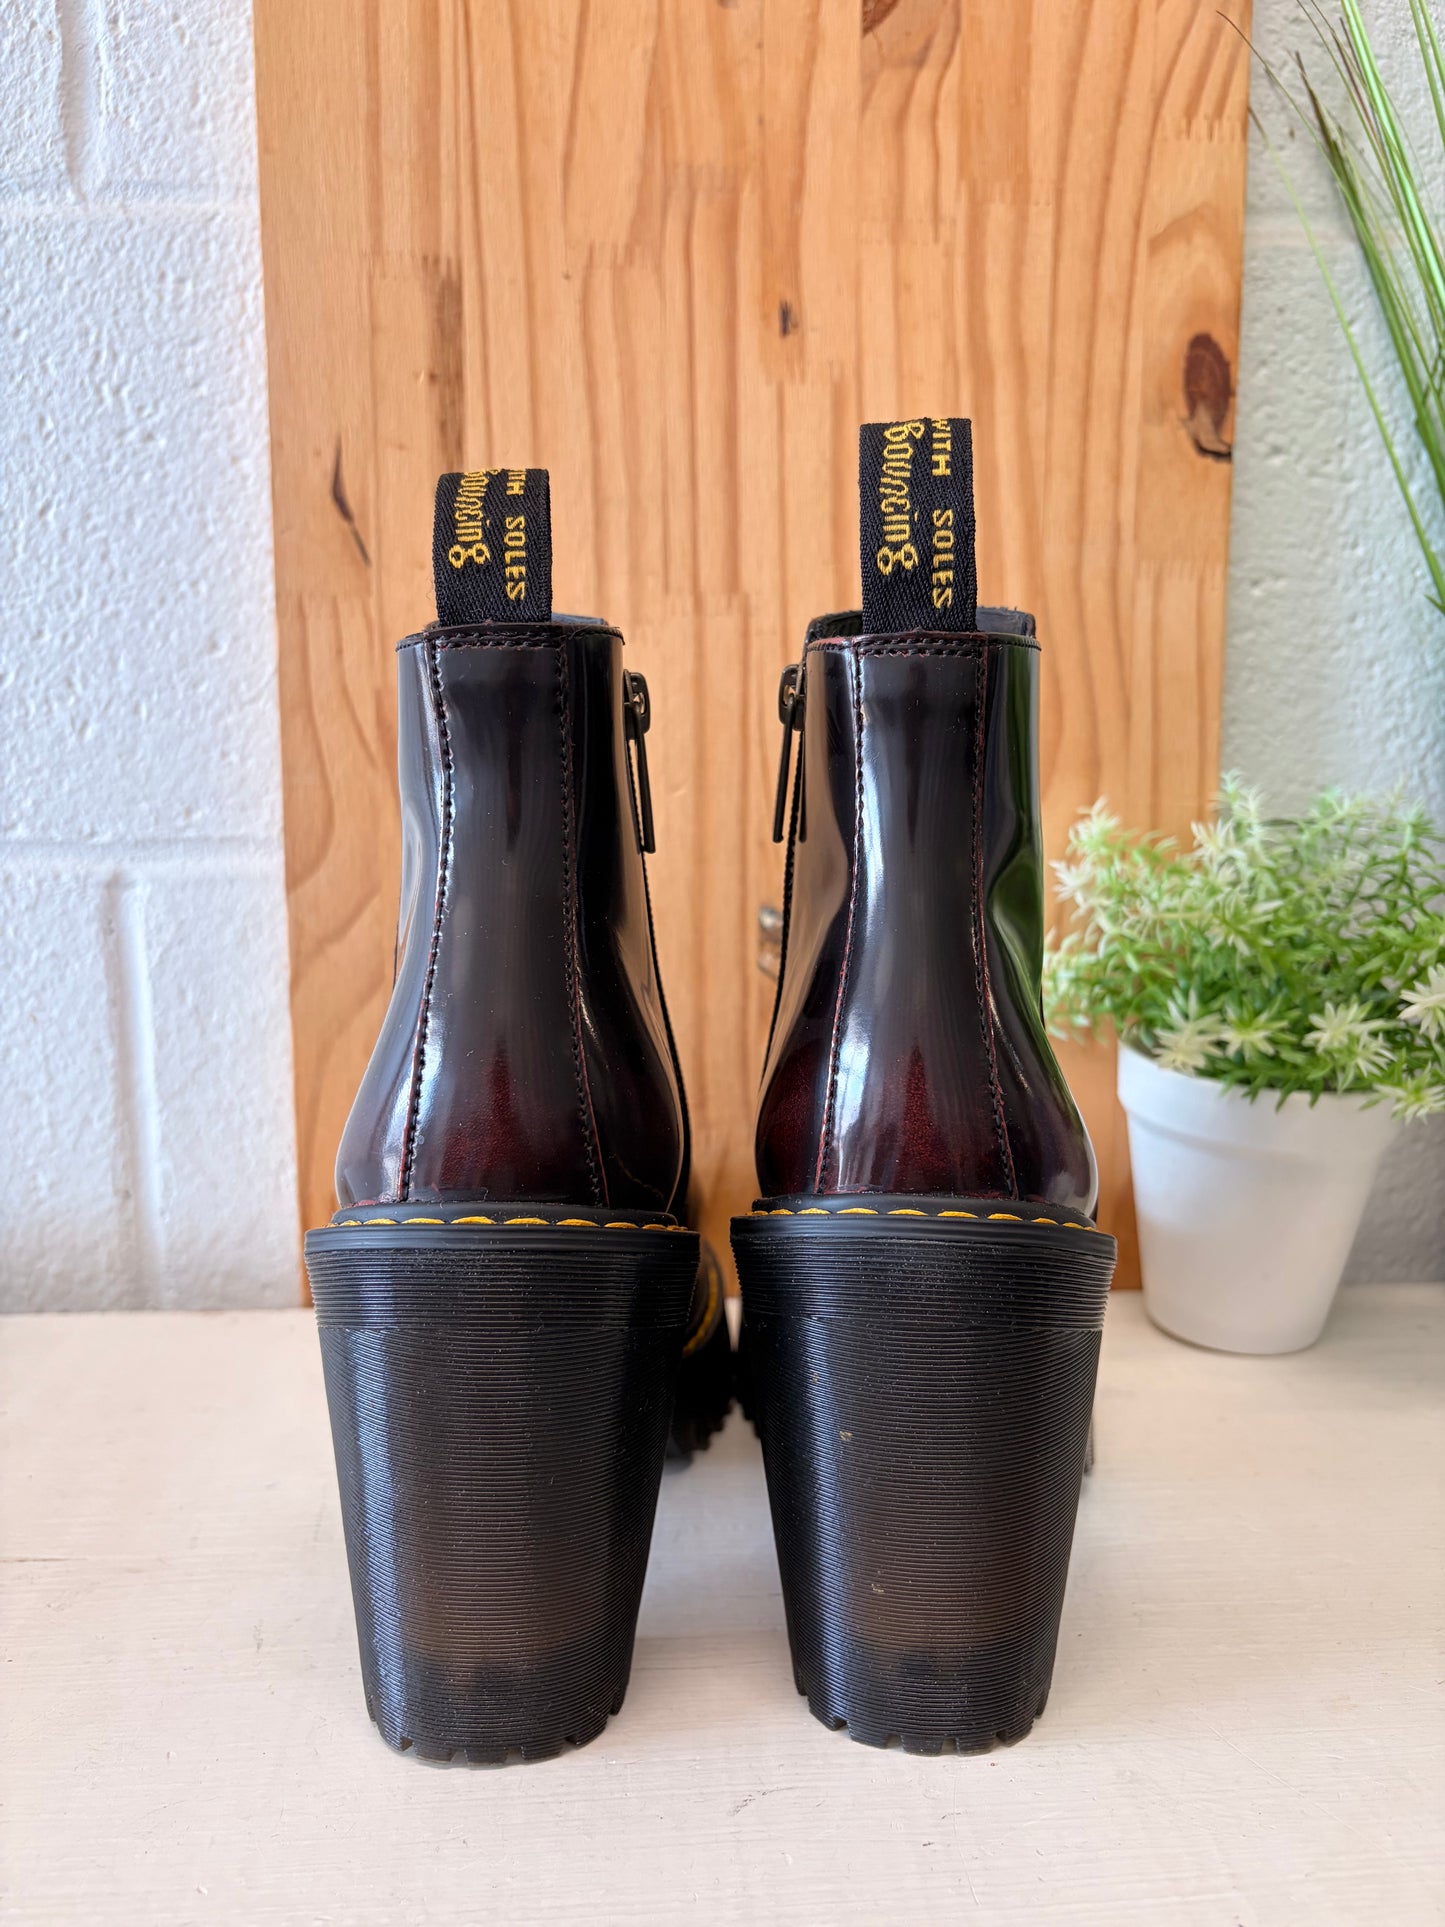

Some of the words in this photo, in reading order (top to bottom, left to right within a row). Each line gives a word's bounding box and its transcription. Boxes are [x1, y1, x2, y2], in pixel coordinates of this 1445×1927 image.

[931, 418, 951, 477] WITH
[877, 420, 925, 576] Bouncing
[504, 515, 526, 601] SOLES
[932, 508, 954, 609] SOLES
